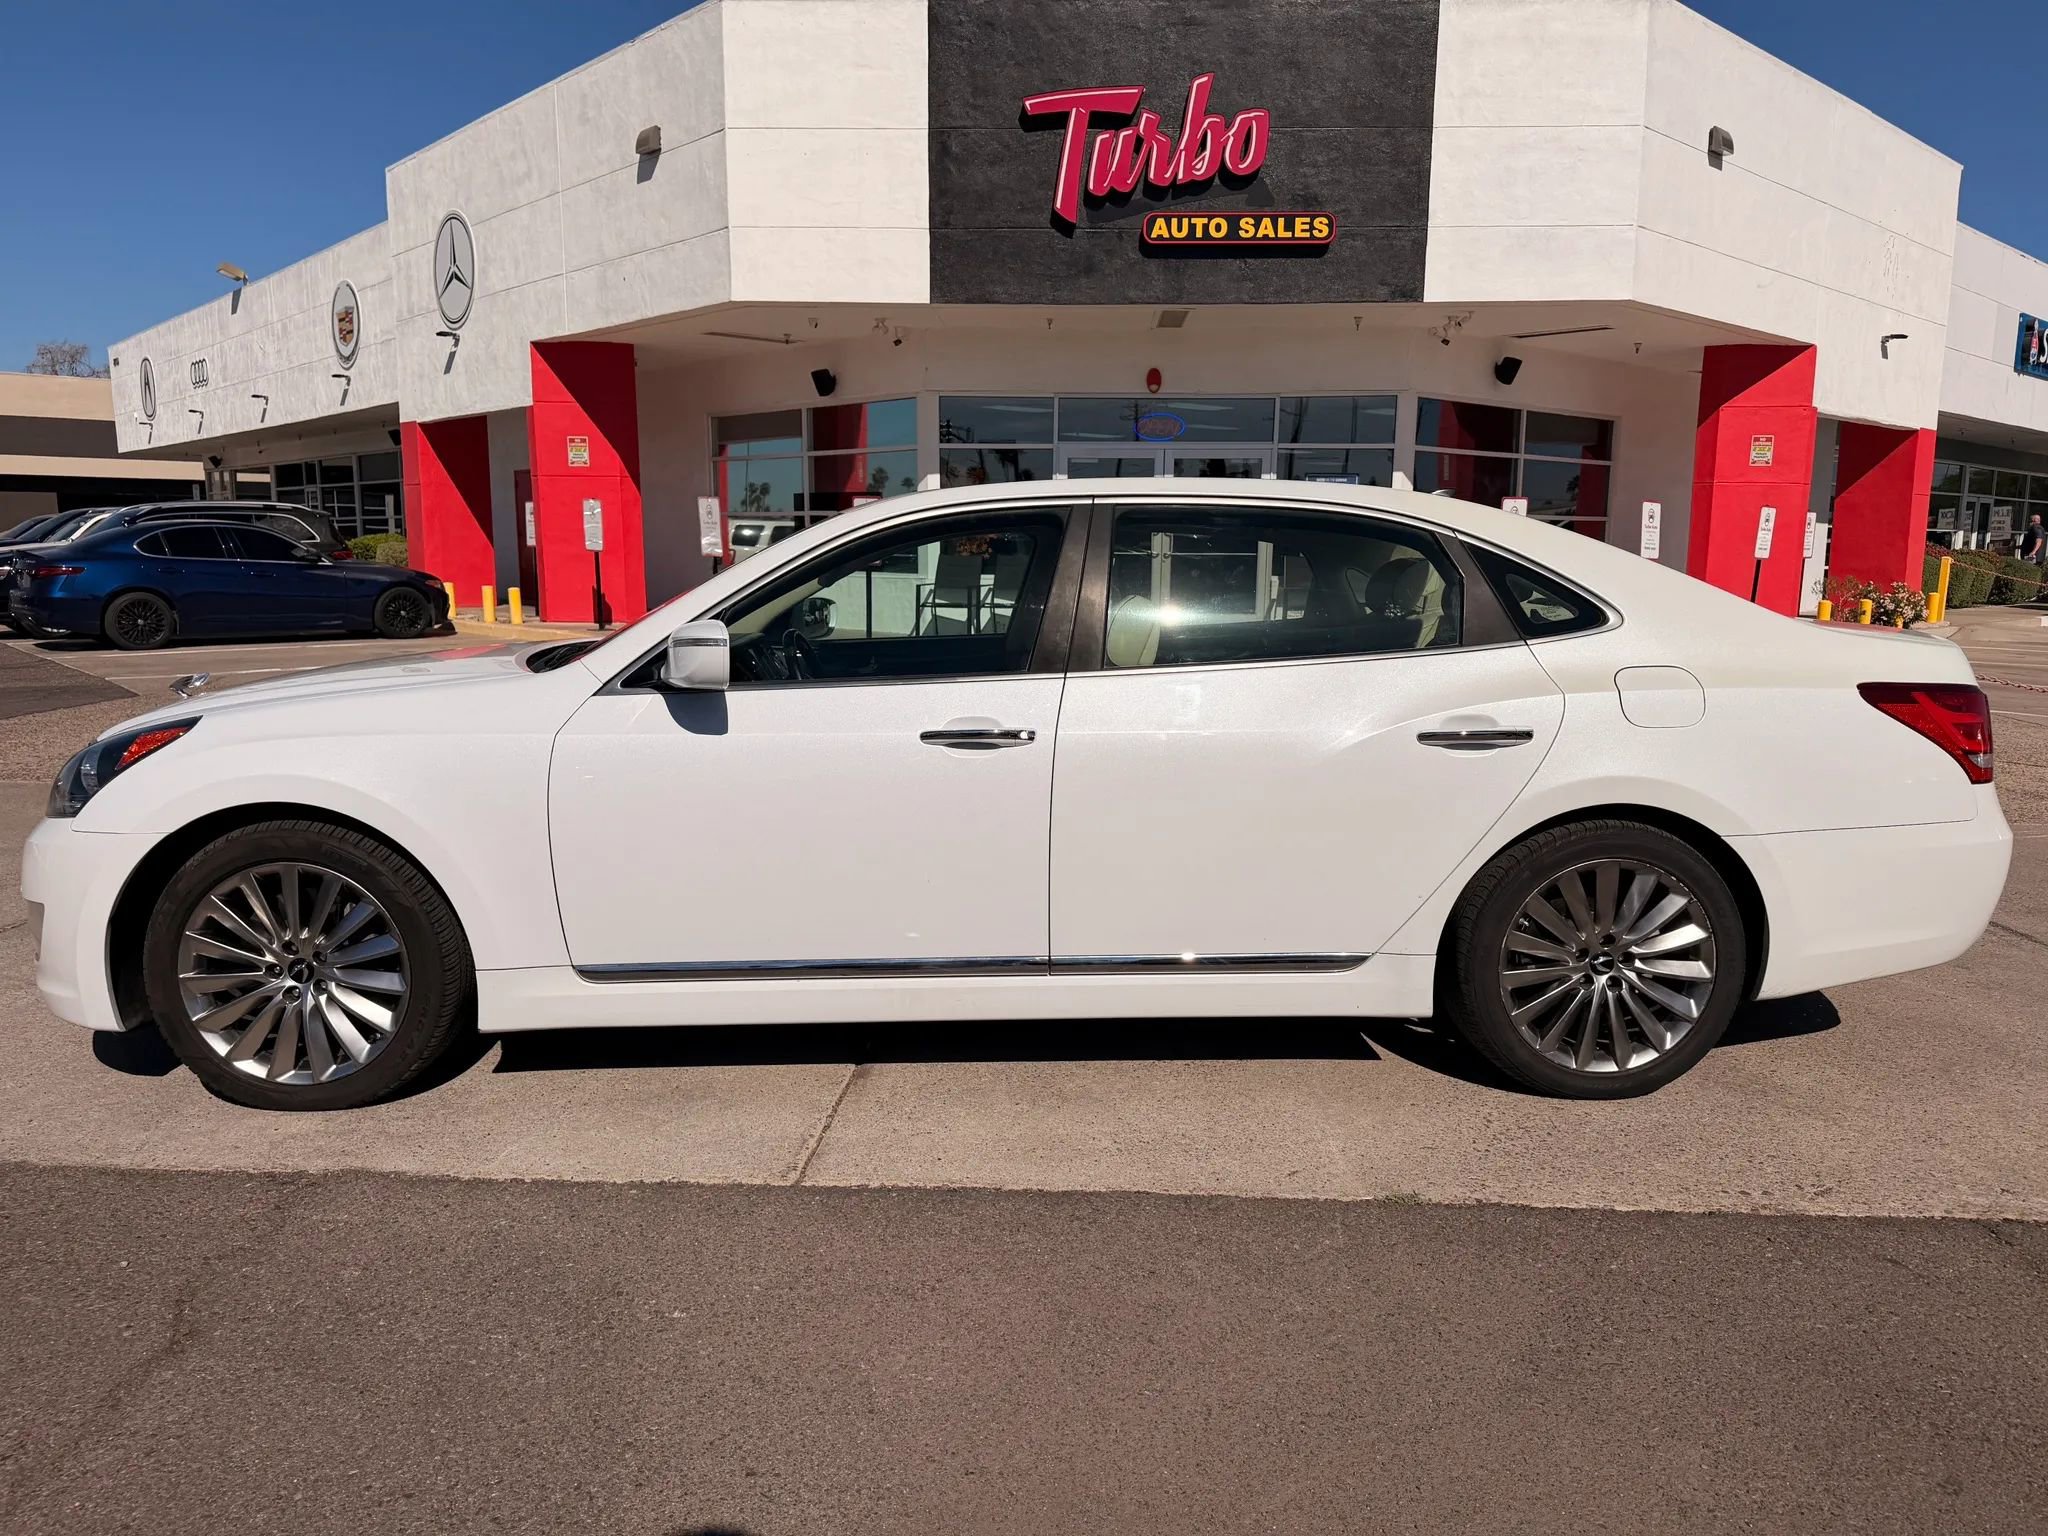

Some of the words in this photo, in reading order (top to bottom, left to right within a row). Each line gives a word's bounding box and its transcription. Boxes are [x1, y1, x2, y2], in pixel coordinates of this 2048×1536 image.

[1023, 72, 1270, 224] Turbo
[1149, 216, 1229, 239] AUTO
[1238, 216, 1330, 239] SALES
